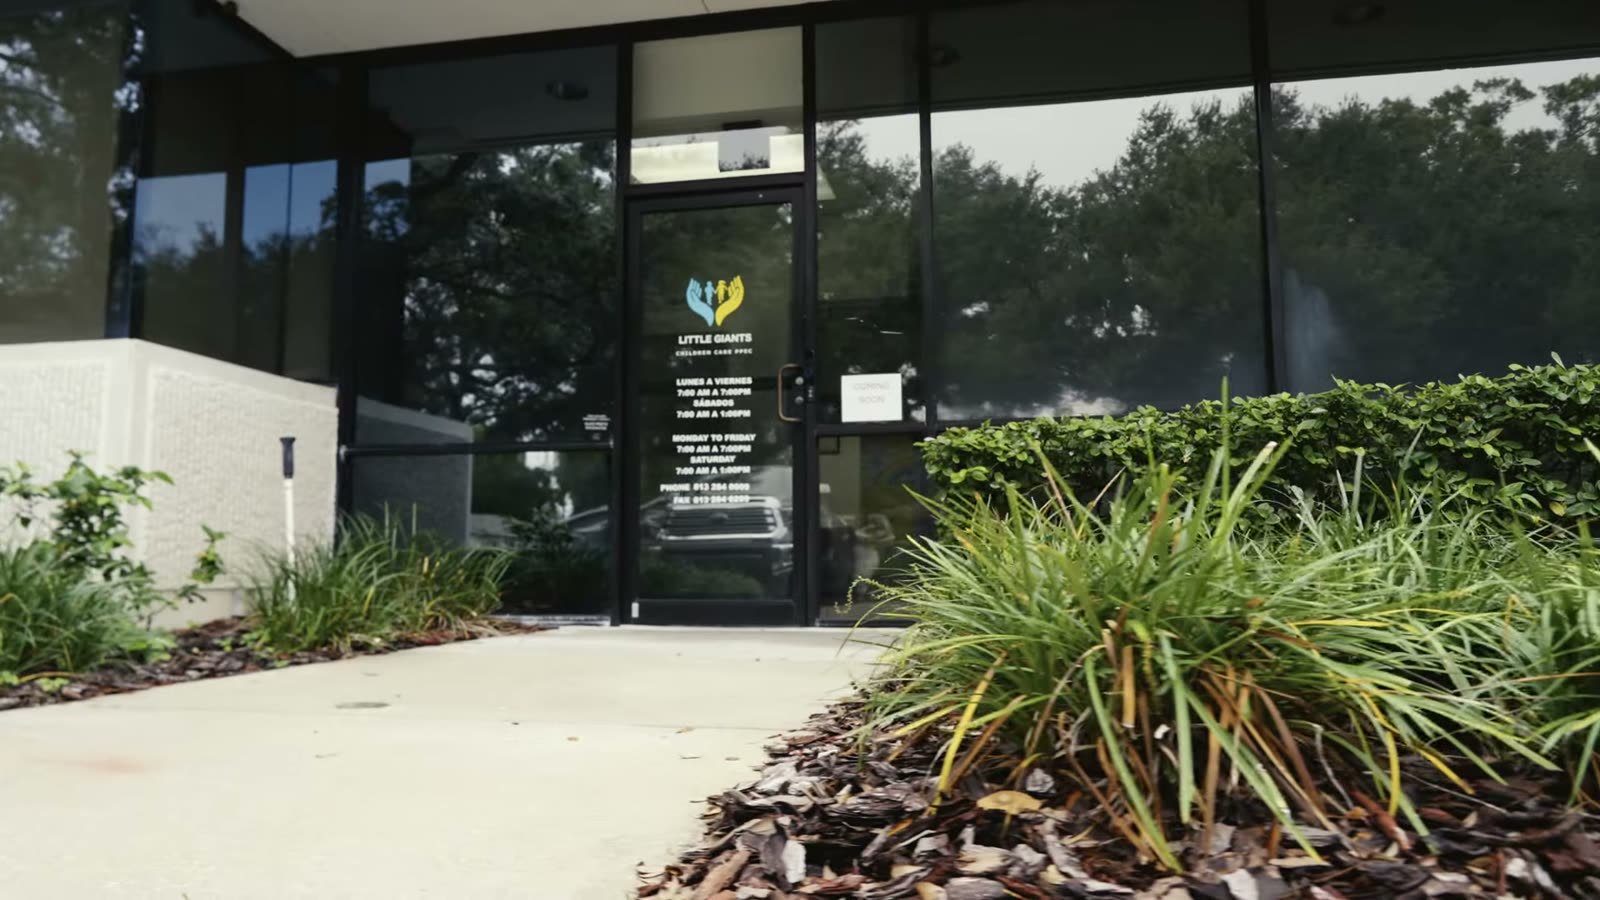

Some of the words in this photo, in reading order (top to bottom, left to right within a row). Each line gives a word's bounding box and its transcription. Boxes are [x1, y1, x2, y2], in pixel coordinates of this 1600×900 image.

[678, 334, 713, 345] LITTLE
[713, 333, 753, 344] GIANTS
[676, 378, 705, 387] LUNES
[706, 378, 714, 386] A
[714, 376, 753, 385] VIERNES
[677, 389, 696, 397] 7:00
[696, 389, 711, 397] AM
[711, 388, 719, 396] A
[720, 388, 752, 396] 7:00PM
[693, 398, 735, 407] SÁBADOS
[676, 410, 695, 418] 7:00
[696, 410, 710, 418] AM
[711, 410, 719, 418] A
[720, 409, 751, 417] 1:00PM
[672, 434, 710, 442] MONDAY
[710, 434, 723, 442] TO
[724, 433, 757, 441] FRIDAY
[676, 445, 695, 453] 7:00
[696, 445, 710, 453] AM
[711, 445, 719, 453] A
[690, 455, 736, 464] SATURDAY
[675, 467, 694, 475] 7:00
[660, 483, 691, 492] PHONE
[673, 496, 691, 504] FAX
